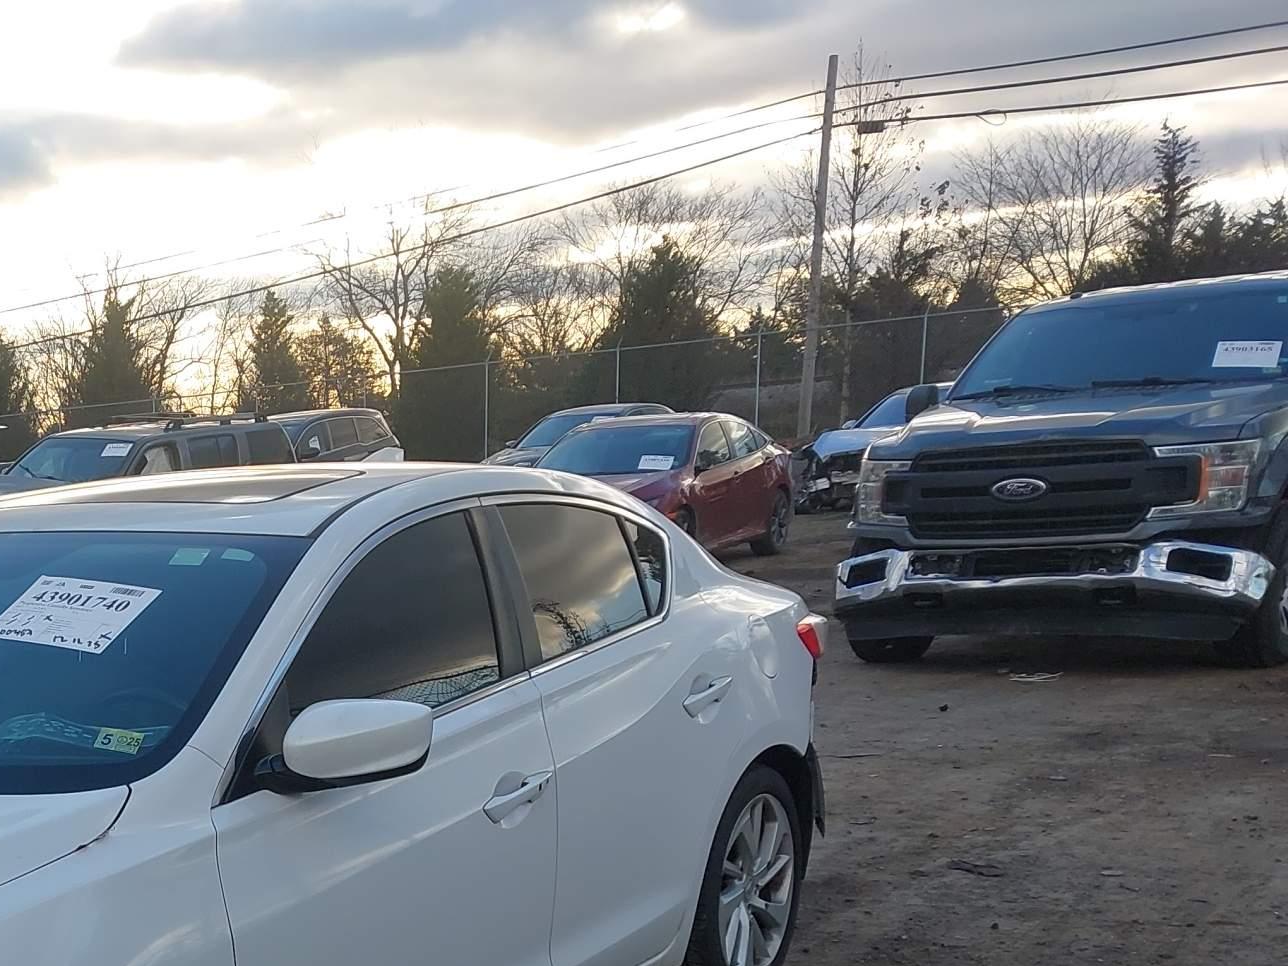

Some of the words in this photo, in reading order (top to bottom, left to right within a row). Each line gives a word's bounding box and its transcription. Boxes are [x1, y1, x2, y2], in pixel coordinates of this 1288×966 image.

[1003, 482, 1034, 496] Ford
[32, 590, 130, 612] 43901740
[100, 733, 114, 746] 5
[127, 736, 142, 748] 25
